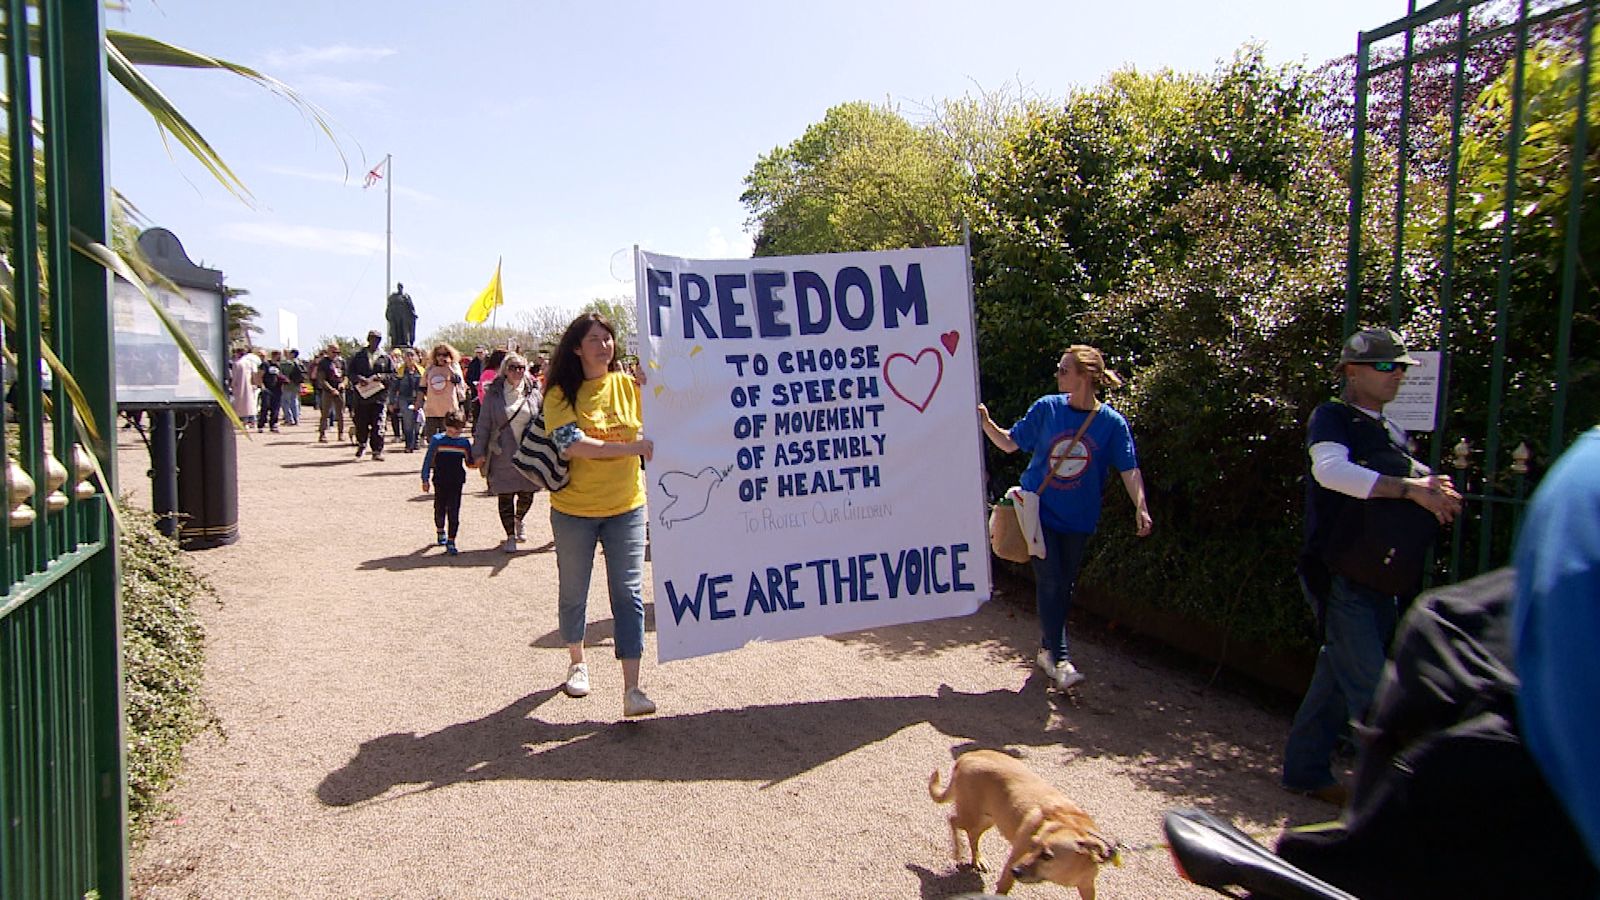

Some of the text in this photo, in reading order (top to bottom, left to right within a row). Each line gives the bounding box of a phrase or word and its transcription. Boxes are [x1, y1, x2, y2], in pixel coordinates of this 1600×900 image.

[647, 263, 929, 339] FREEDOM
[725, 345, 880, 377] TO CHOOSE
[730, 376, 880, 408] OF SPEECH
[733, 404, 885, 439] OF MOVEMENT
[736, 433, 887, 470] OF ASSEMBLY
[738, 465, 881, 502] OF HEALTH
[664, 543, 975, 626] WE ARE THE VOICE
